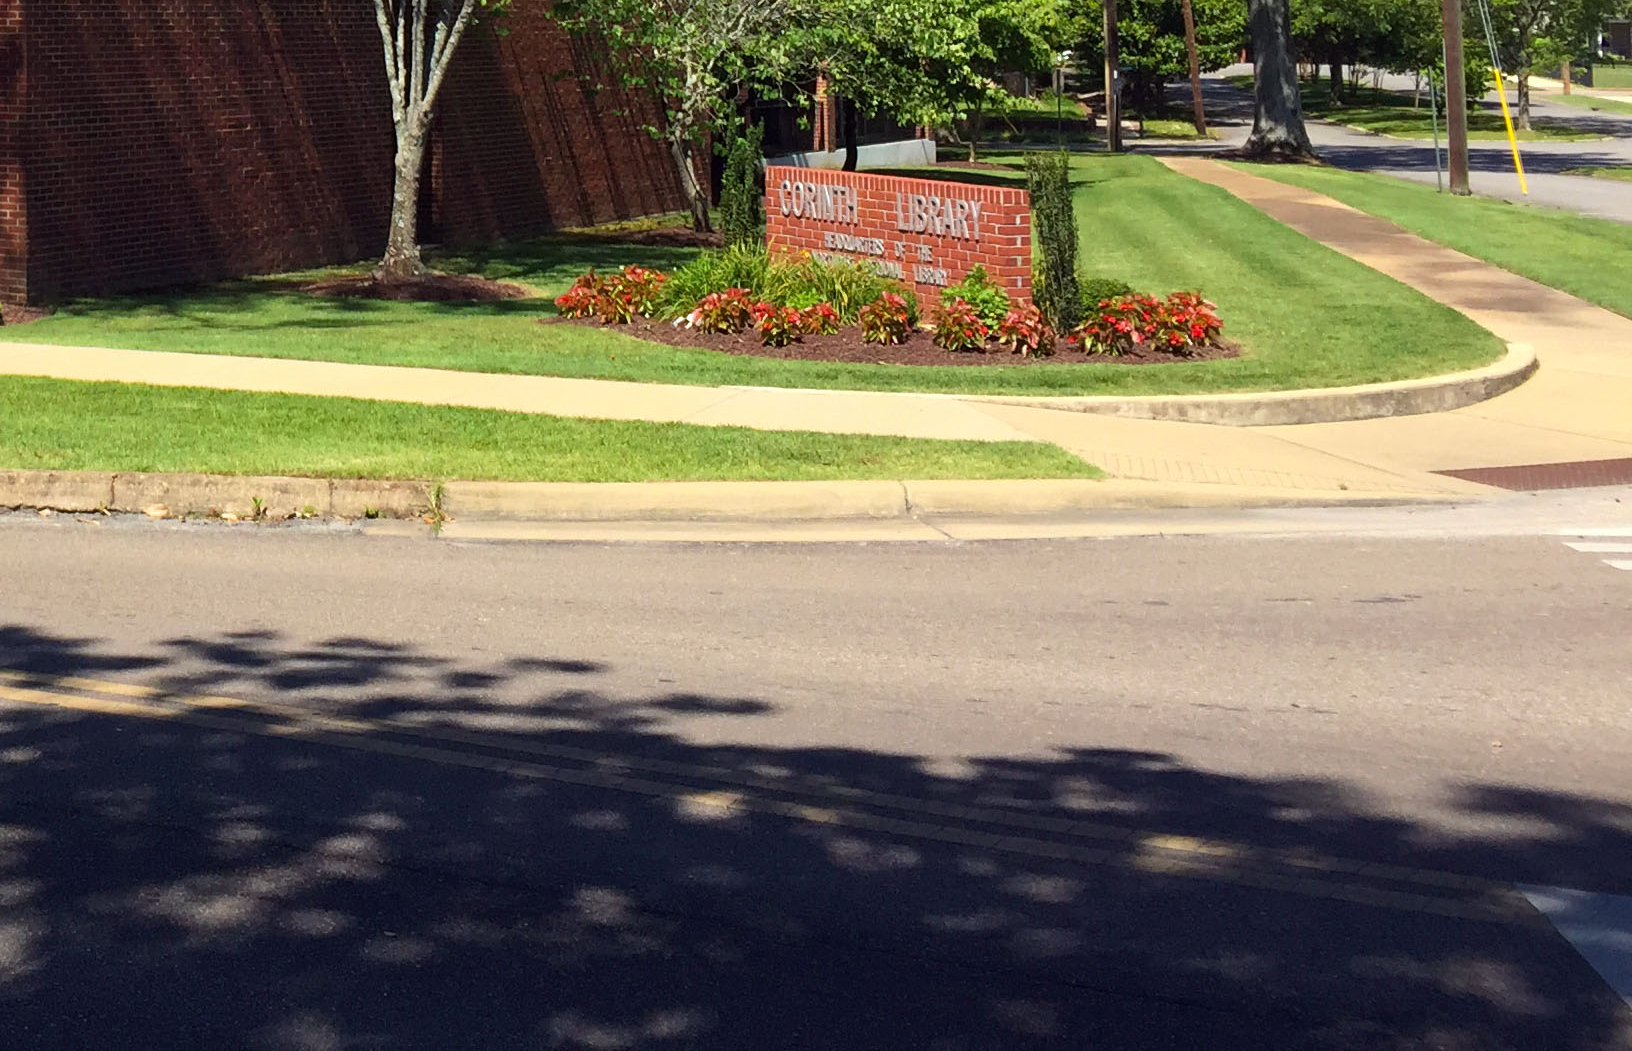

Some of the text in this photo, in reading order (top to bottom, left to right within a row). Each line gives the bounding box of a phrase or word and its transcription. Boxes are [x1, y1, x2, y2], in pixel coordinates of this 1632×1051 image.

[779, 179, 983, 241] CORINTH LIBRARY
[915, 244, 933, 262] THE
[913, 264, 948, 286] LIBRARY
